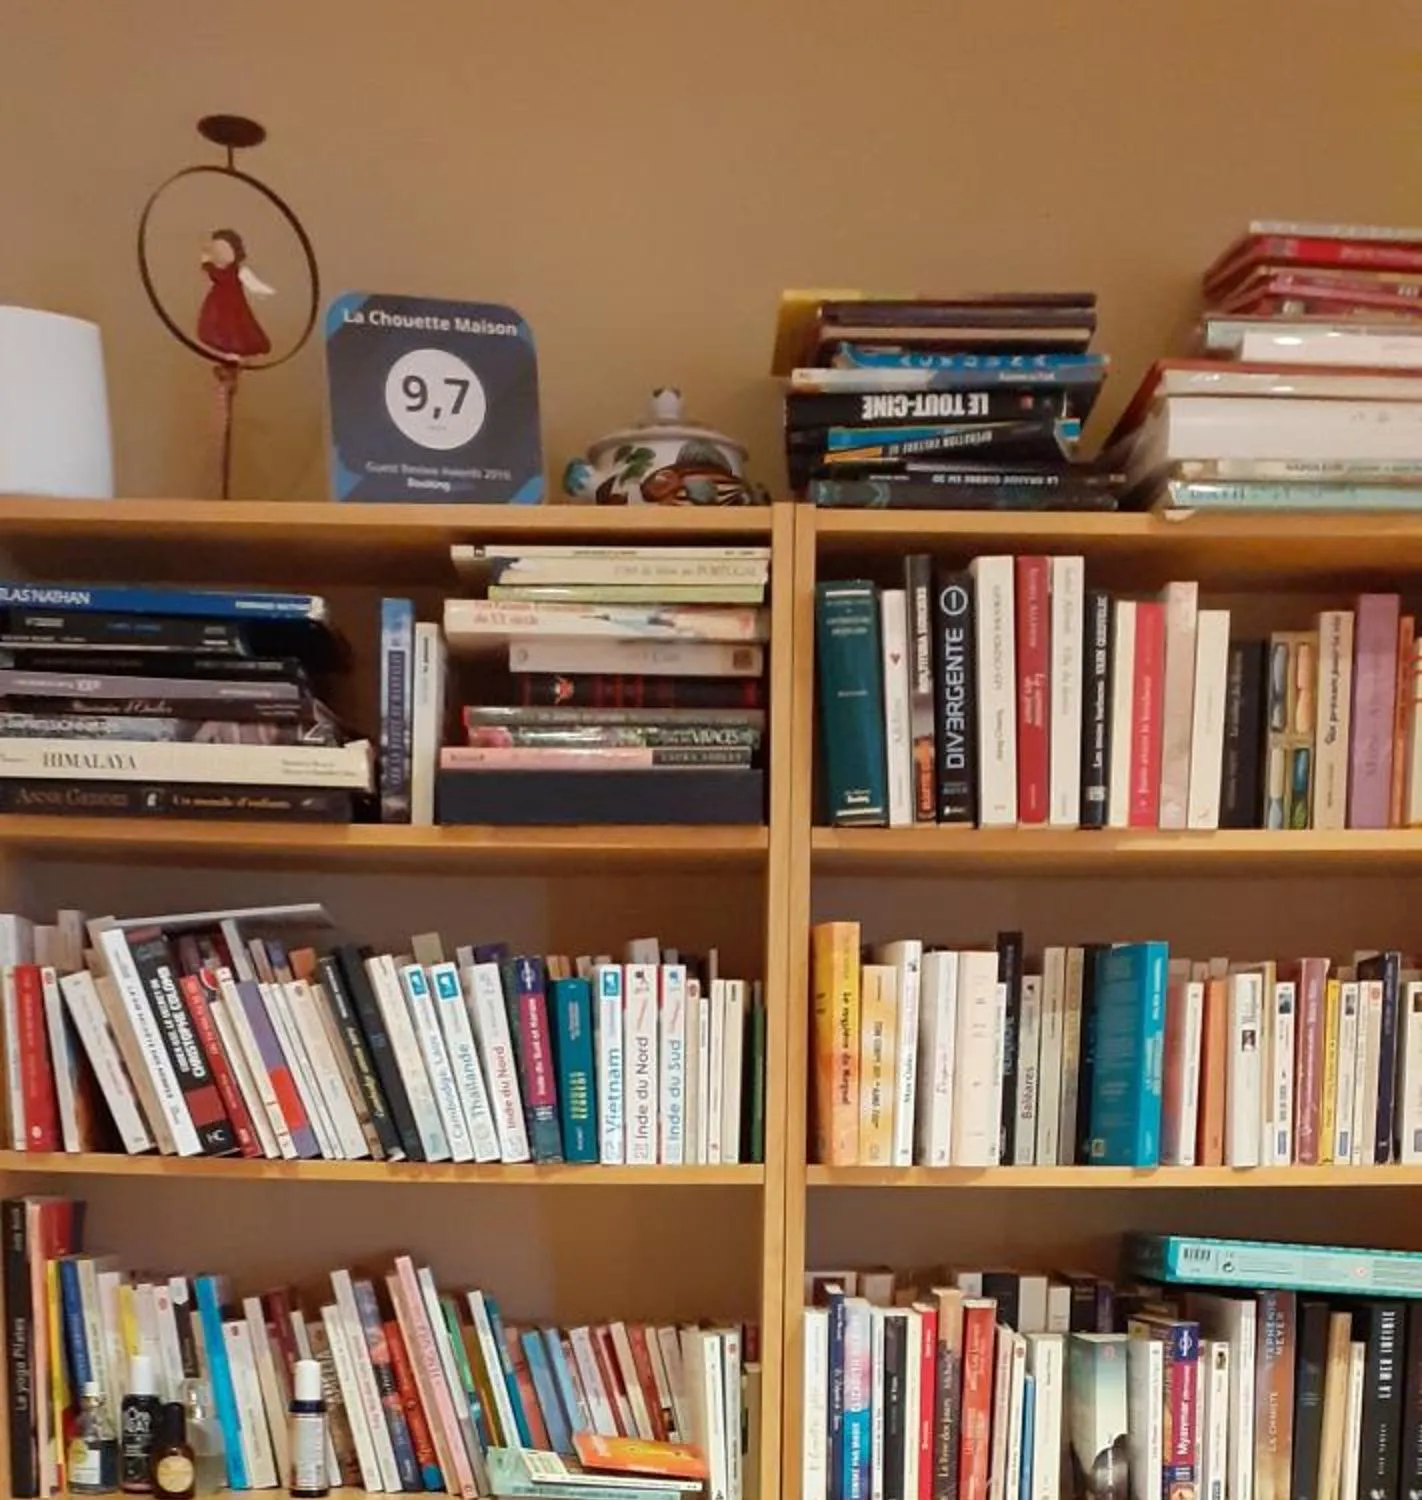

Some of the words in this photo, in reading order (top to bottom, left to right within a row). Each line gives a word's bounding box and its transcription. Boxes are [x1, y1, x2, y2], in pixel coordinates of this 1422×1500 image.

[341, 308, 365, 324] La
[369, 310, 451, 331] Chouette
[454, 317, 517, 336] Maison
[401, 374, 471, 421] 9,7
[967, 393, 989, 416] LE
[0, 587, 37, 603] LAS
[37, 589, 91, 607] NATHAN
[945, 627, 965, 770] DIVERGENTE
[42, 752, 138, 771] HIMALAYA
[158, 965, 184, 1011] COLOMB
[173, 1011, 206, 1078] CHRISTOPHE
[633, 1036, 649, 1075] Nord
[666, 1039, 681, 1071] Sud
[492, 1046, 508, 1079] Nord
[498, 1081, 512, 1099] du
[603, 1047, 620, 1136] Vietnam
[633, 1079, 649, 1100] du
[666, 1077, 681, 1099] du
[503, 1100, 517, 1130] Inde
[633, 1104, 649, 1140] Inde
[666, 1104, 681, 1142] Inde
[13, 1316, 26, 1359] Pilates
[17, 1361, 30, 1393] yoga
[14, 1395, 26, 1411] Le
[1177, 1400, 1191, 1456] Myanmar
